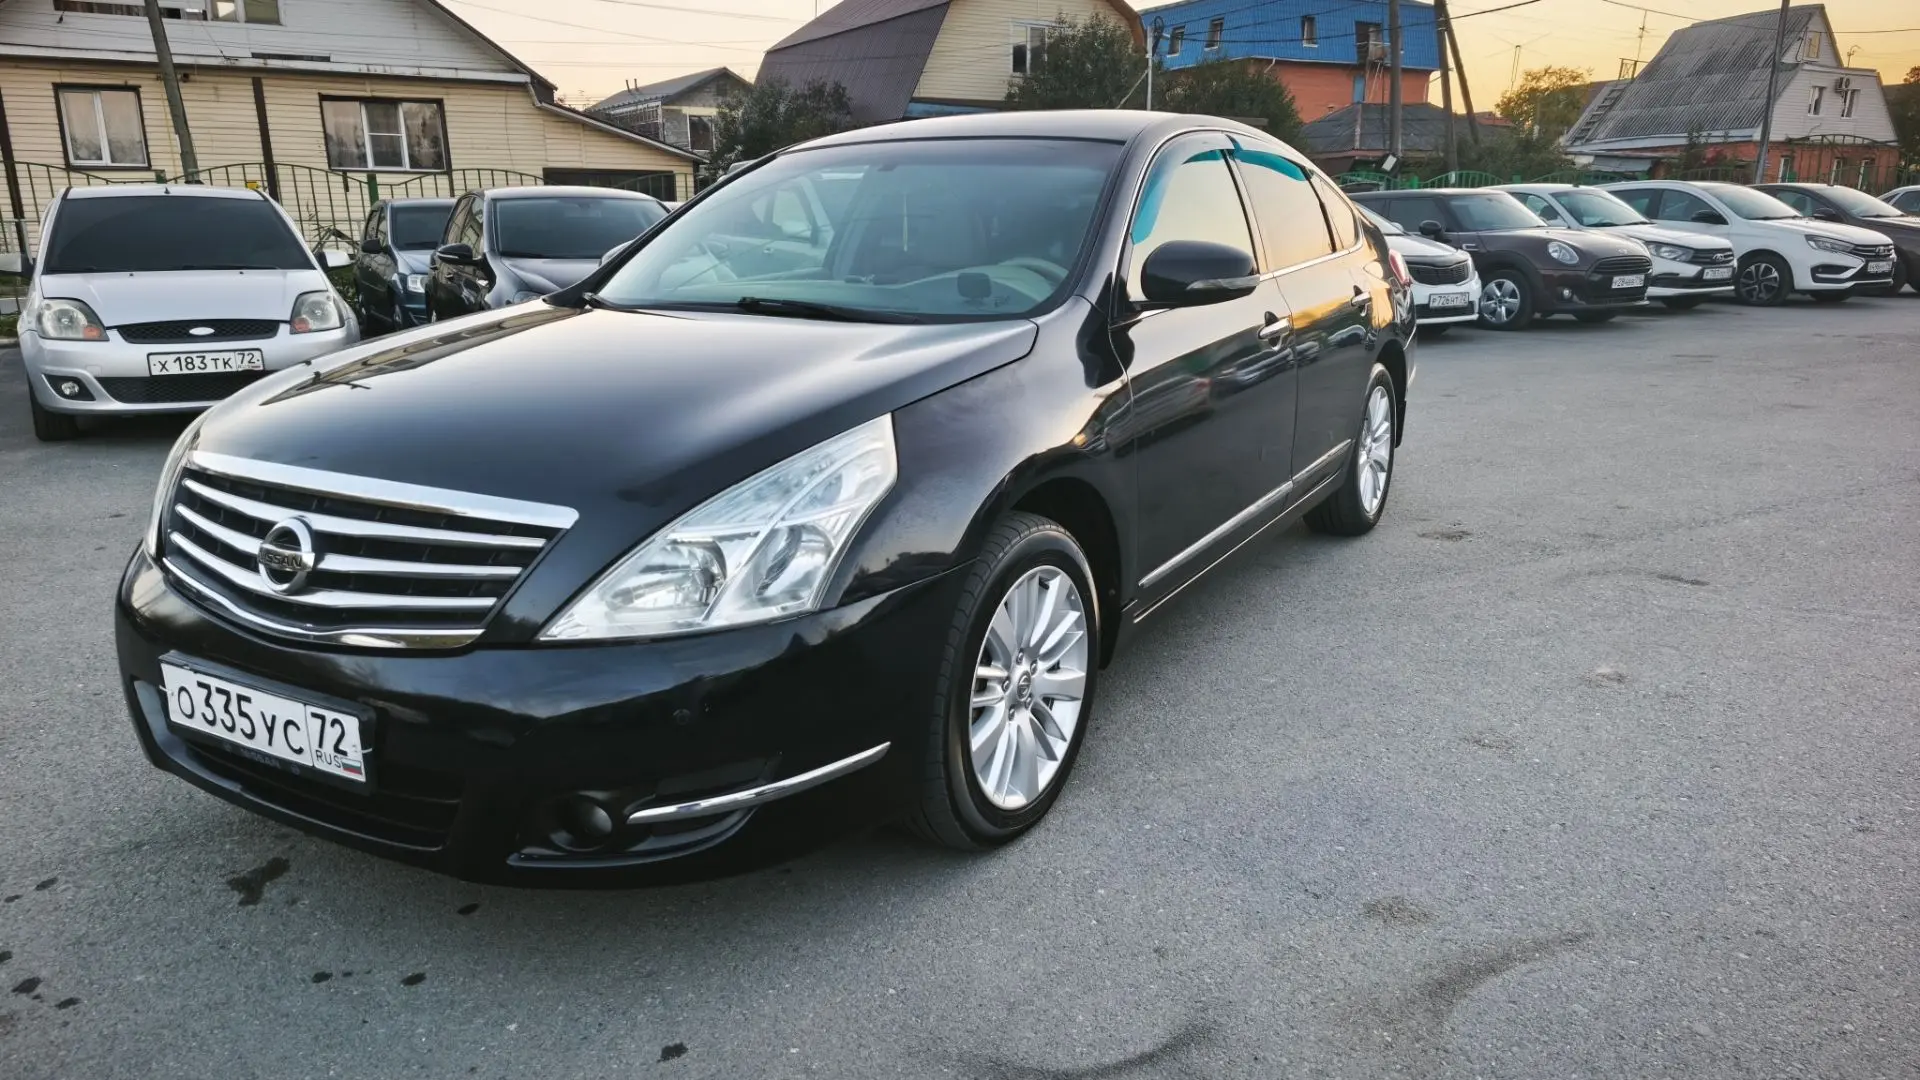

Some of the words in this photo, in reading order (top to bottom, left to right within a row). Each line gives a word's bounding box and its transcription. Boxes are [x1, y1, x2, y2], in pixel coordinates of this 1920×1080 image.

[237, 353, 256, 365] 72
[177, 680, 304, 755] О335УС
[310, 711, 348, 757] 72
[315, 749, 342, 769] RUS
